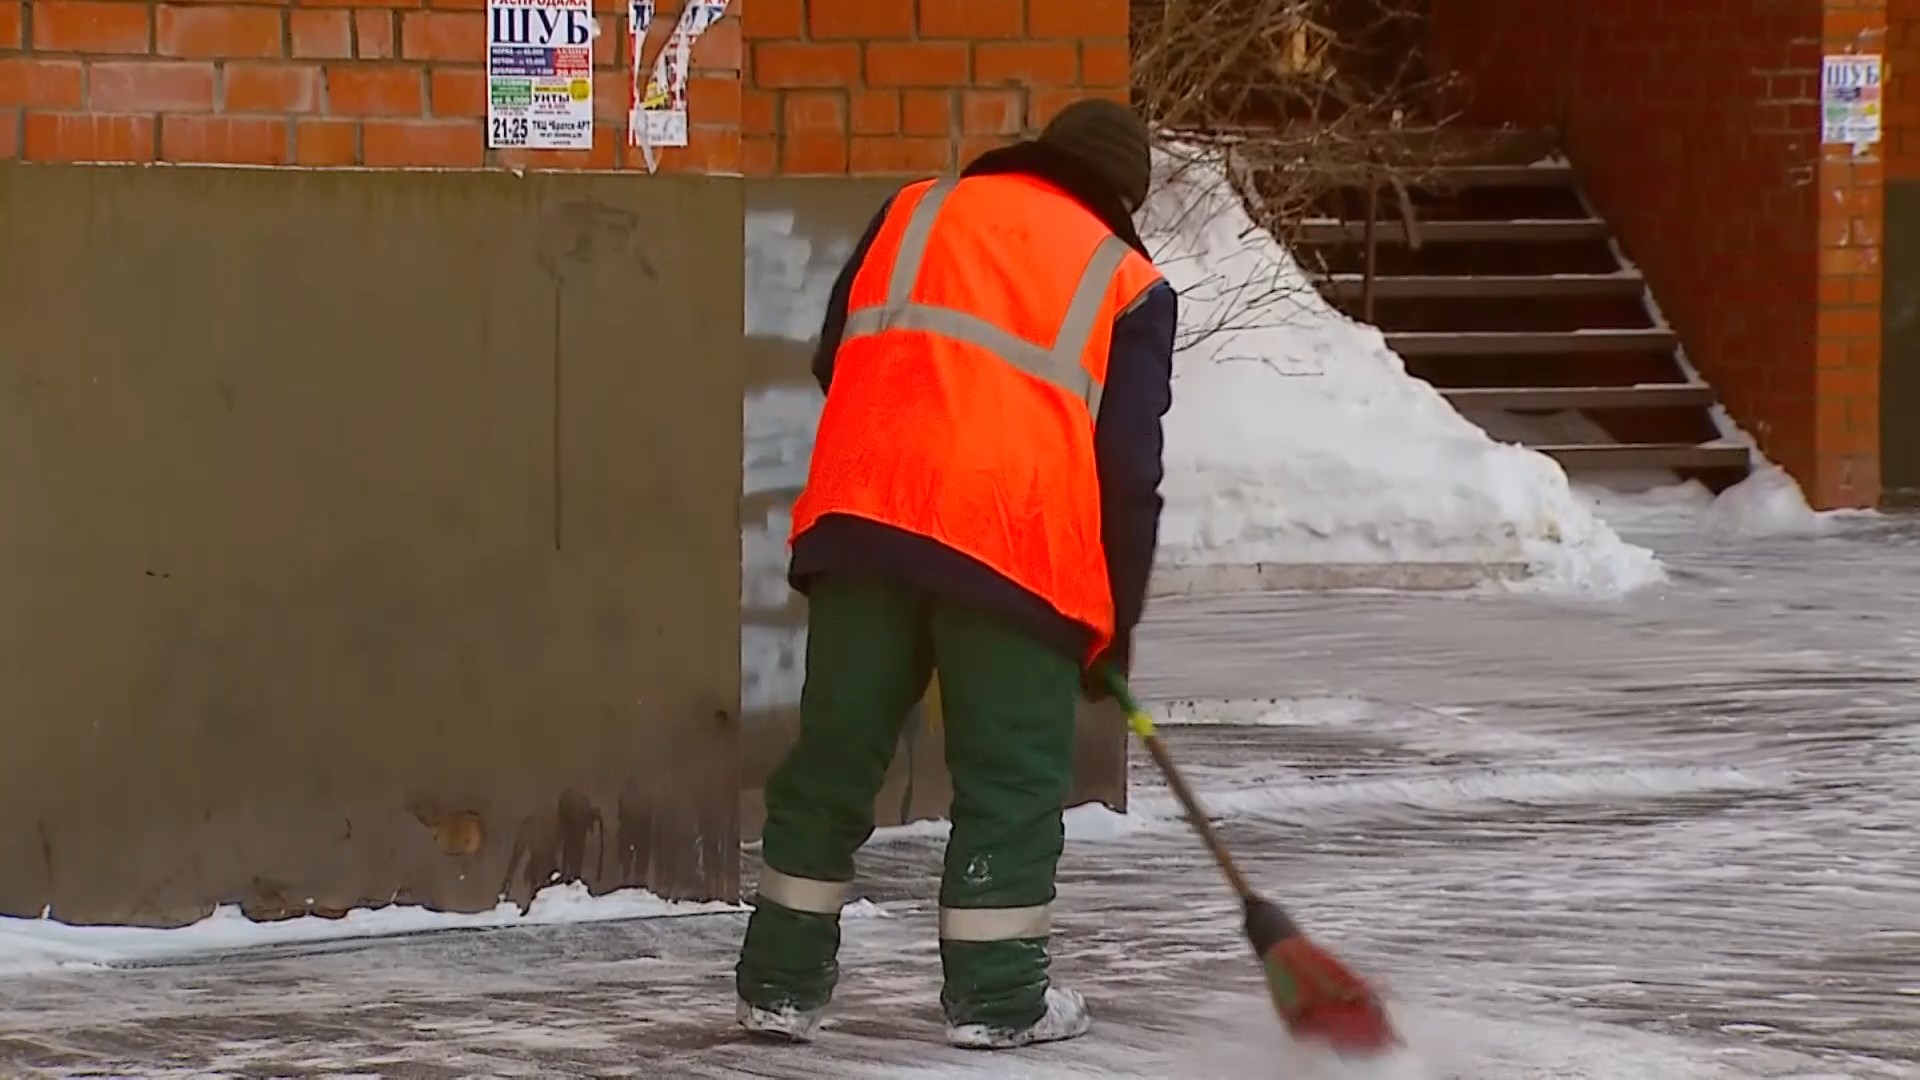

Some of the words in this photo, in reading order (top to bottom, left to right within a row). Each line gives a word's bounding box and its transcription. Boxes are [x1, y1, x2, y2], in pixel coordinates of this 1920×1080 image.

[492, 7, 589, 44] ШУБ
[1827, 64, 1880, 85] ШУБ
[534, 94, 570, 102] УНТЫ
[493, 117, 528, 138] 21-25
